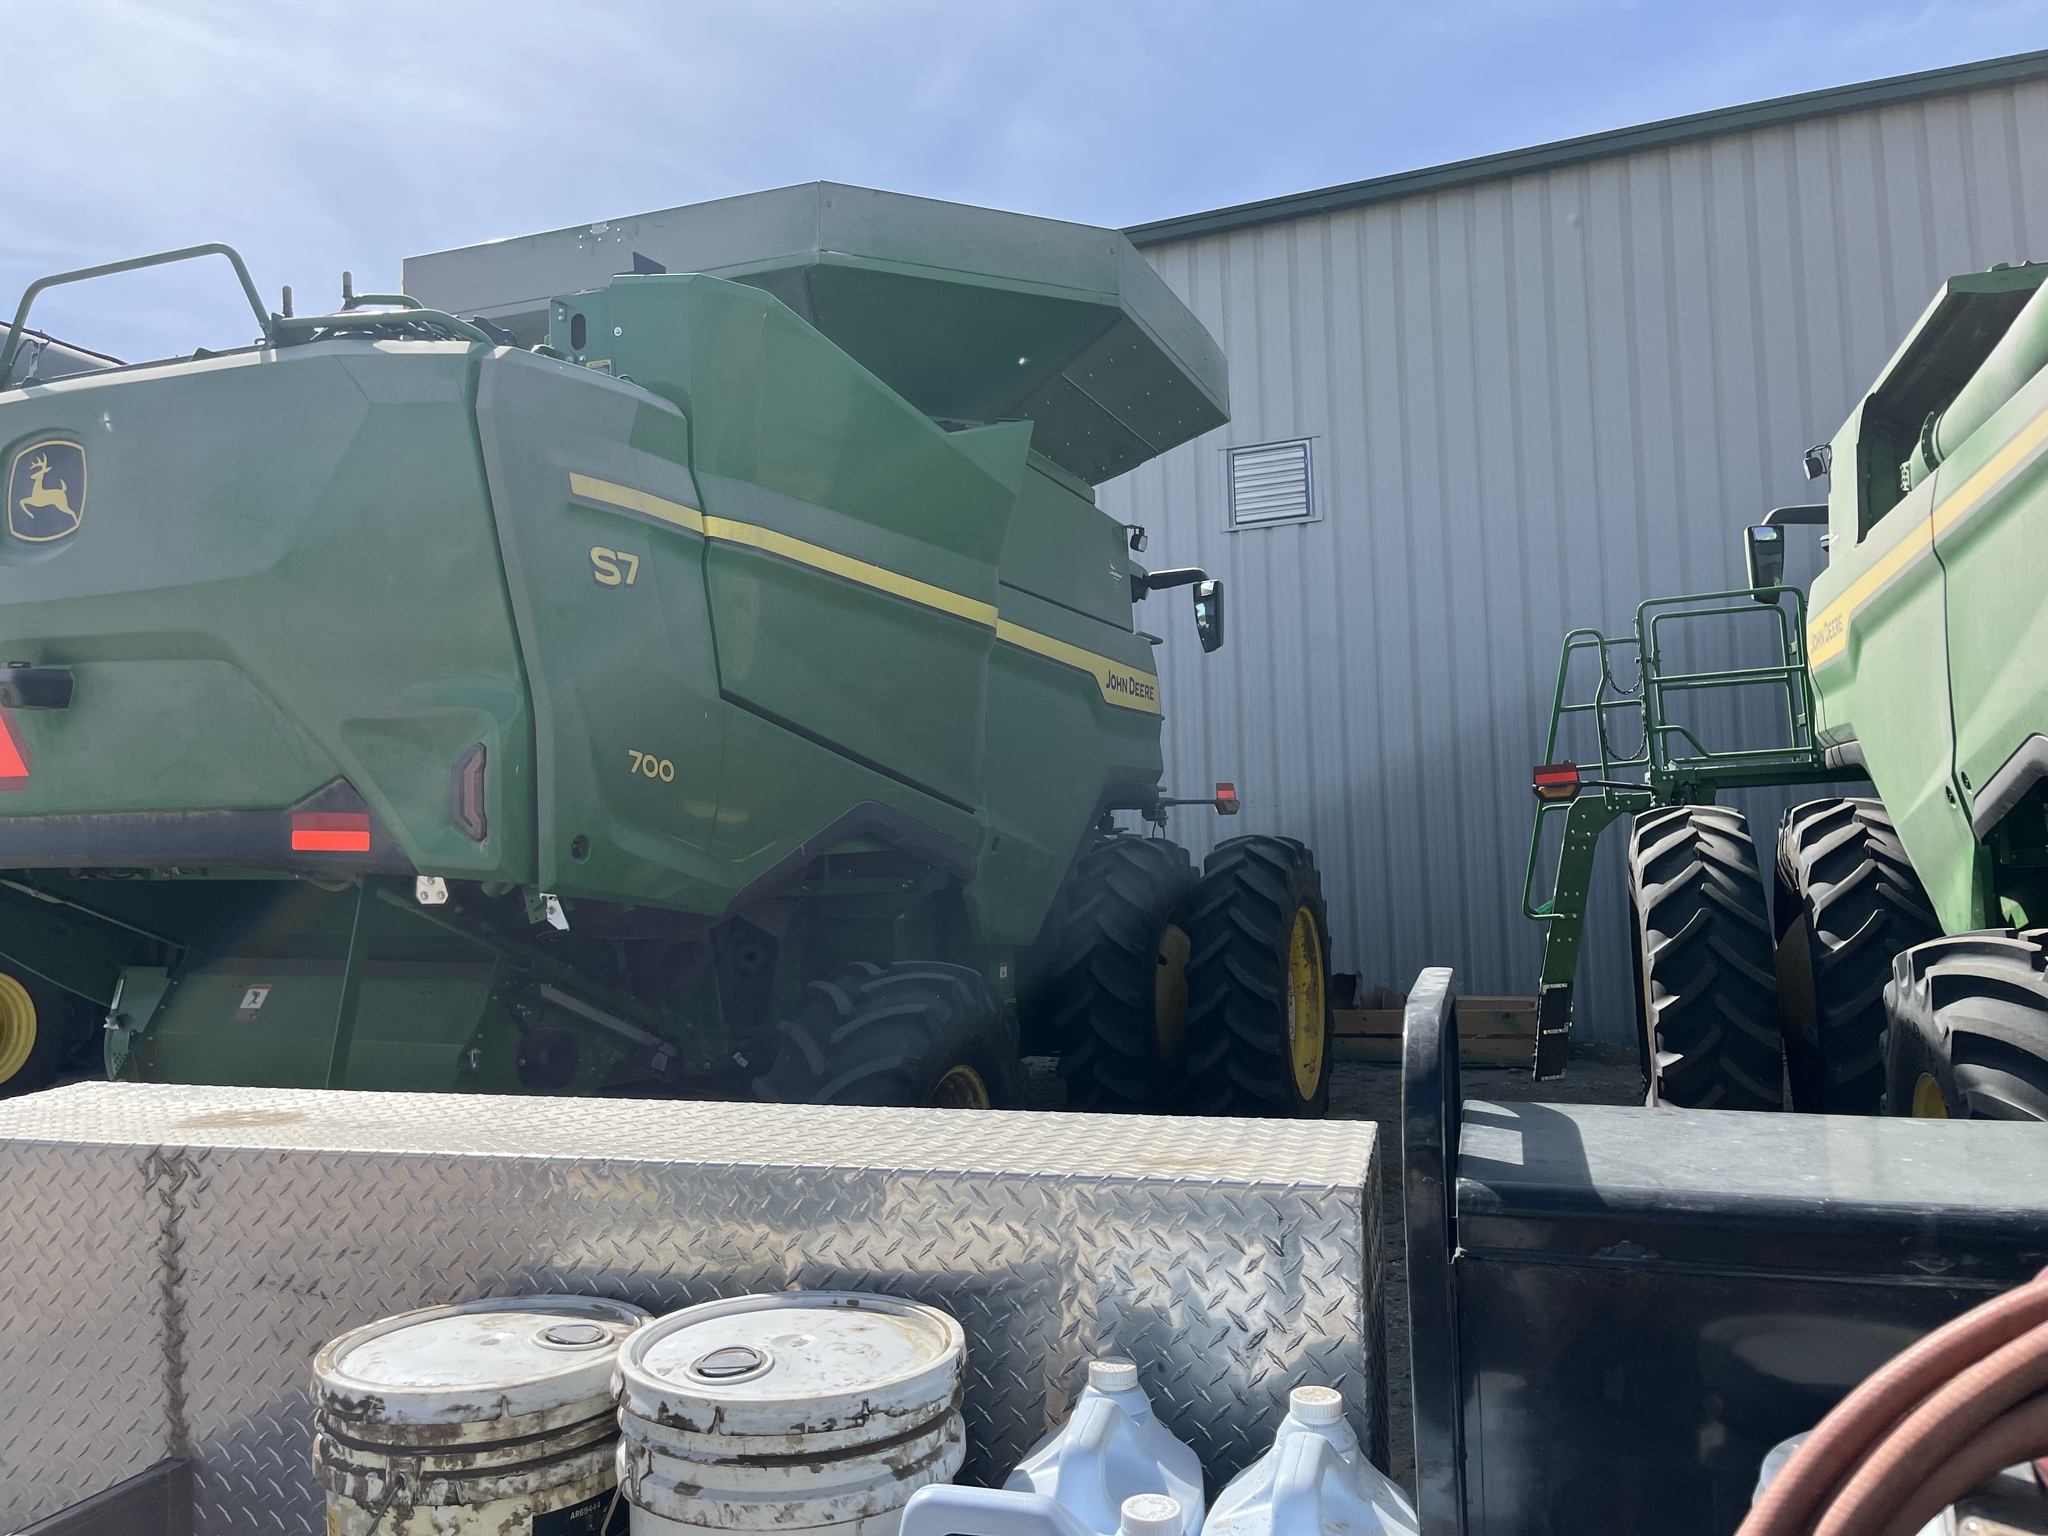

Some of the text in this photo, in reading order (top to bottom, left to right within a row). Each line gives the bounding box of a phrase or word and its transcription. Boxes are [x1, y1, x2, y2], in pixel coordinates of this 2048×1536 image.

[590, 546, 639, 586] S7
[1106, 670, 1154, 700] JOHN DEERE
[628, 749, 675, 782] 700
